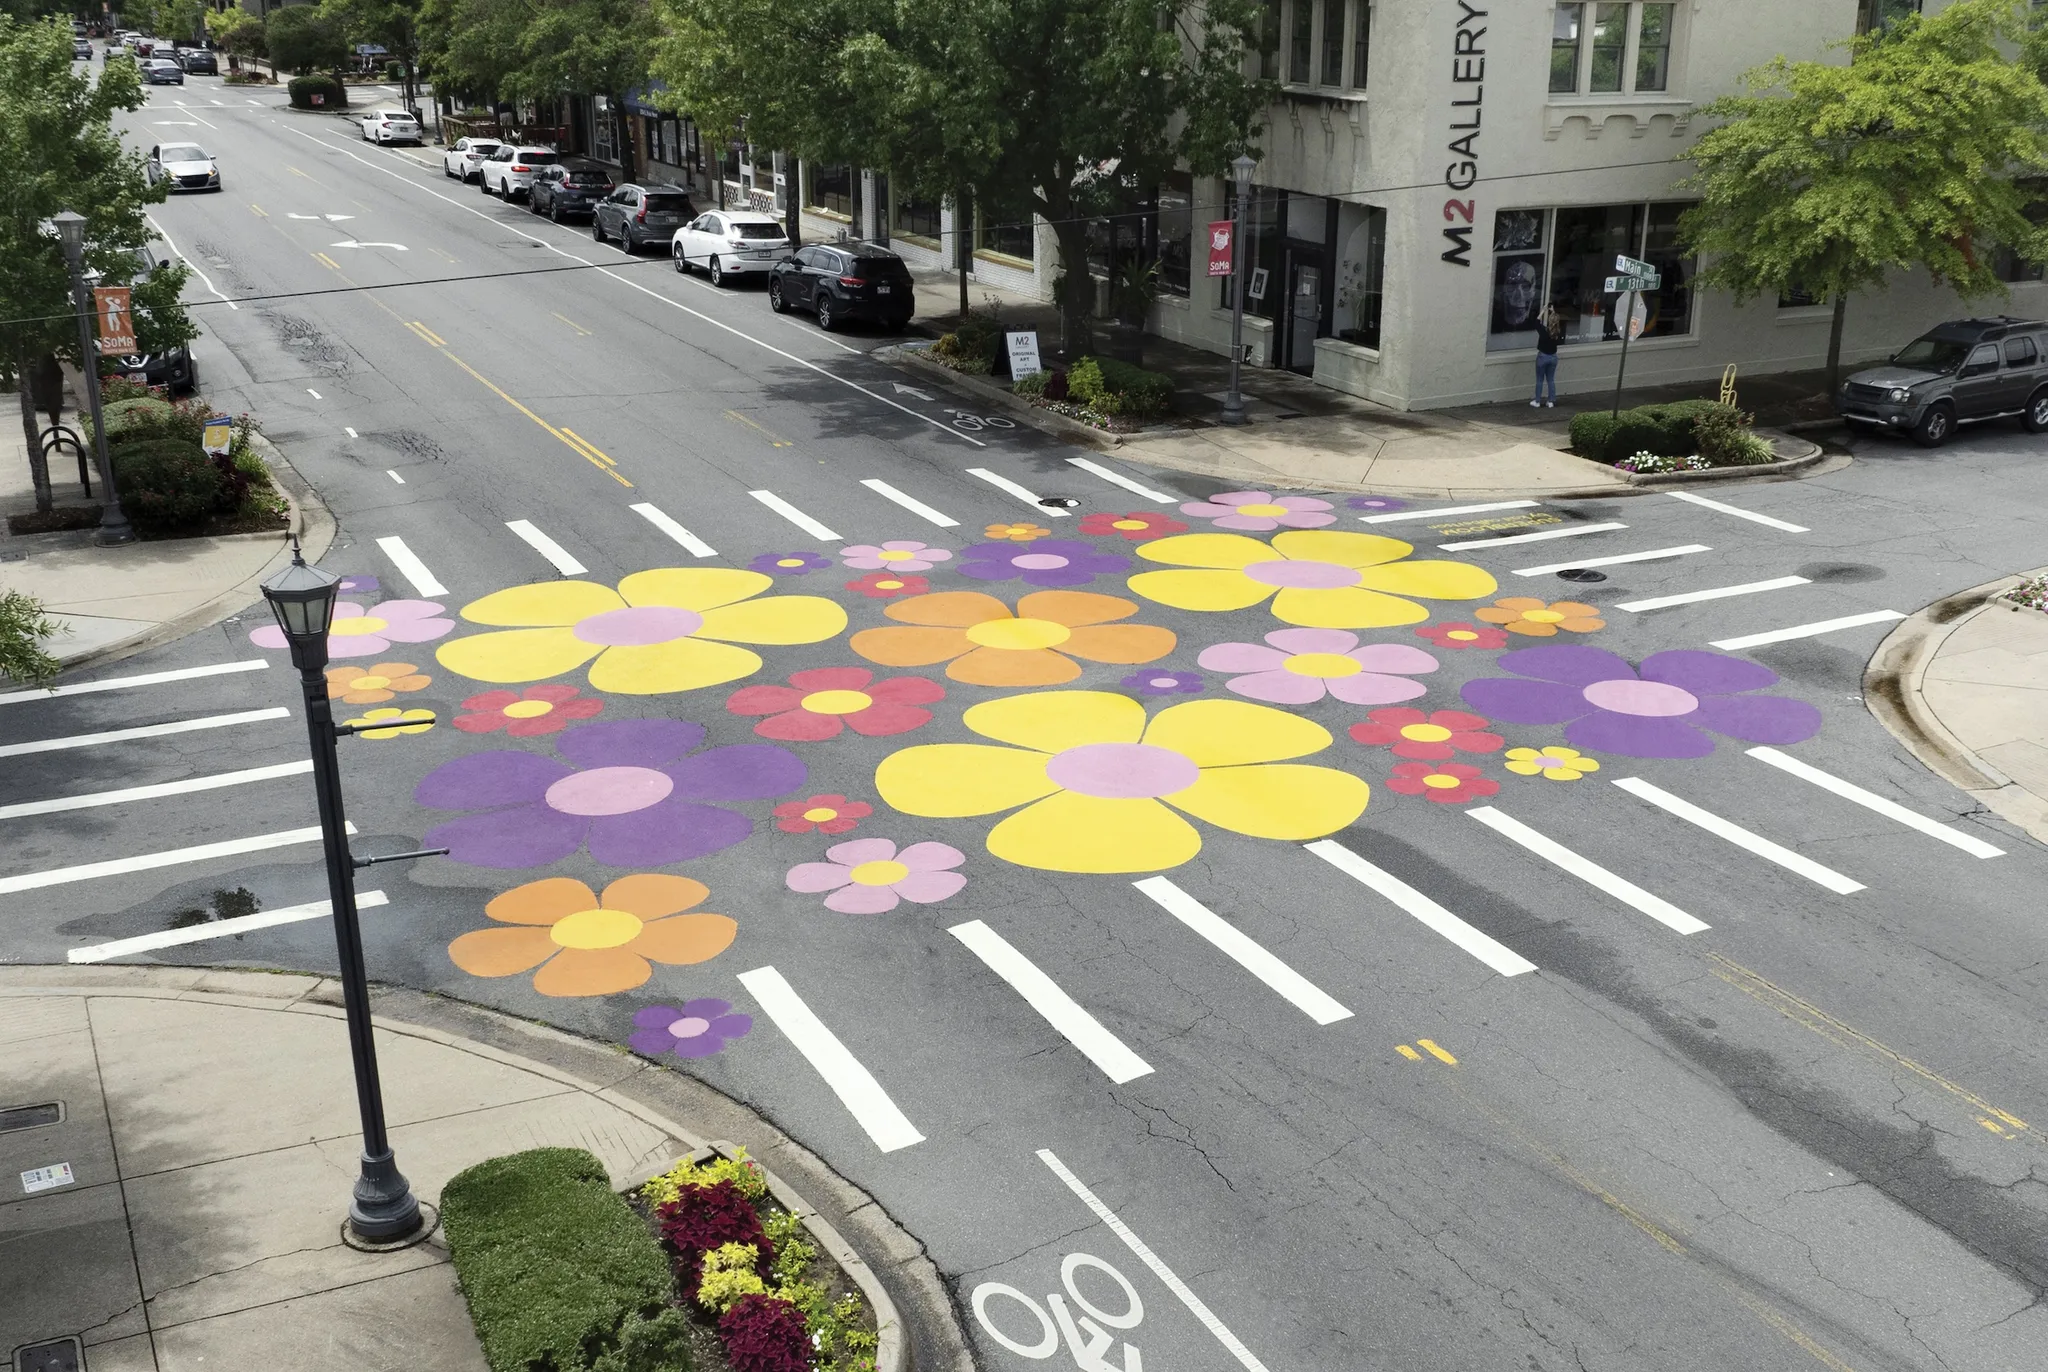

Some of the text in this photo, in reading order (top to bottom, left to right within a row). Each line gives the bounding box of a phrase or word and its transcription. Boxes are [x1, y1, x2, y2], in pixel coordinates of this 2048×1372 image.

[1440, 0, 1488, 267] M2 GALLERY
[1625, 260, 1642, 275] Main
[1628, 278, 1645, 290] 13th
[1016, 336, 1030, 346] M2
